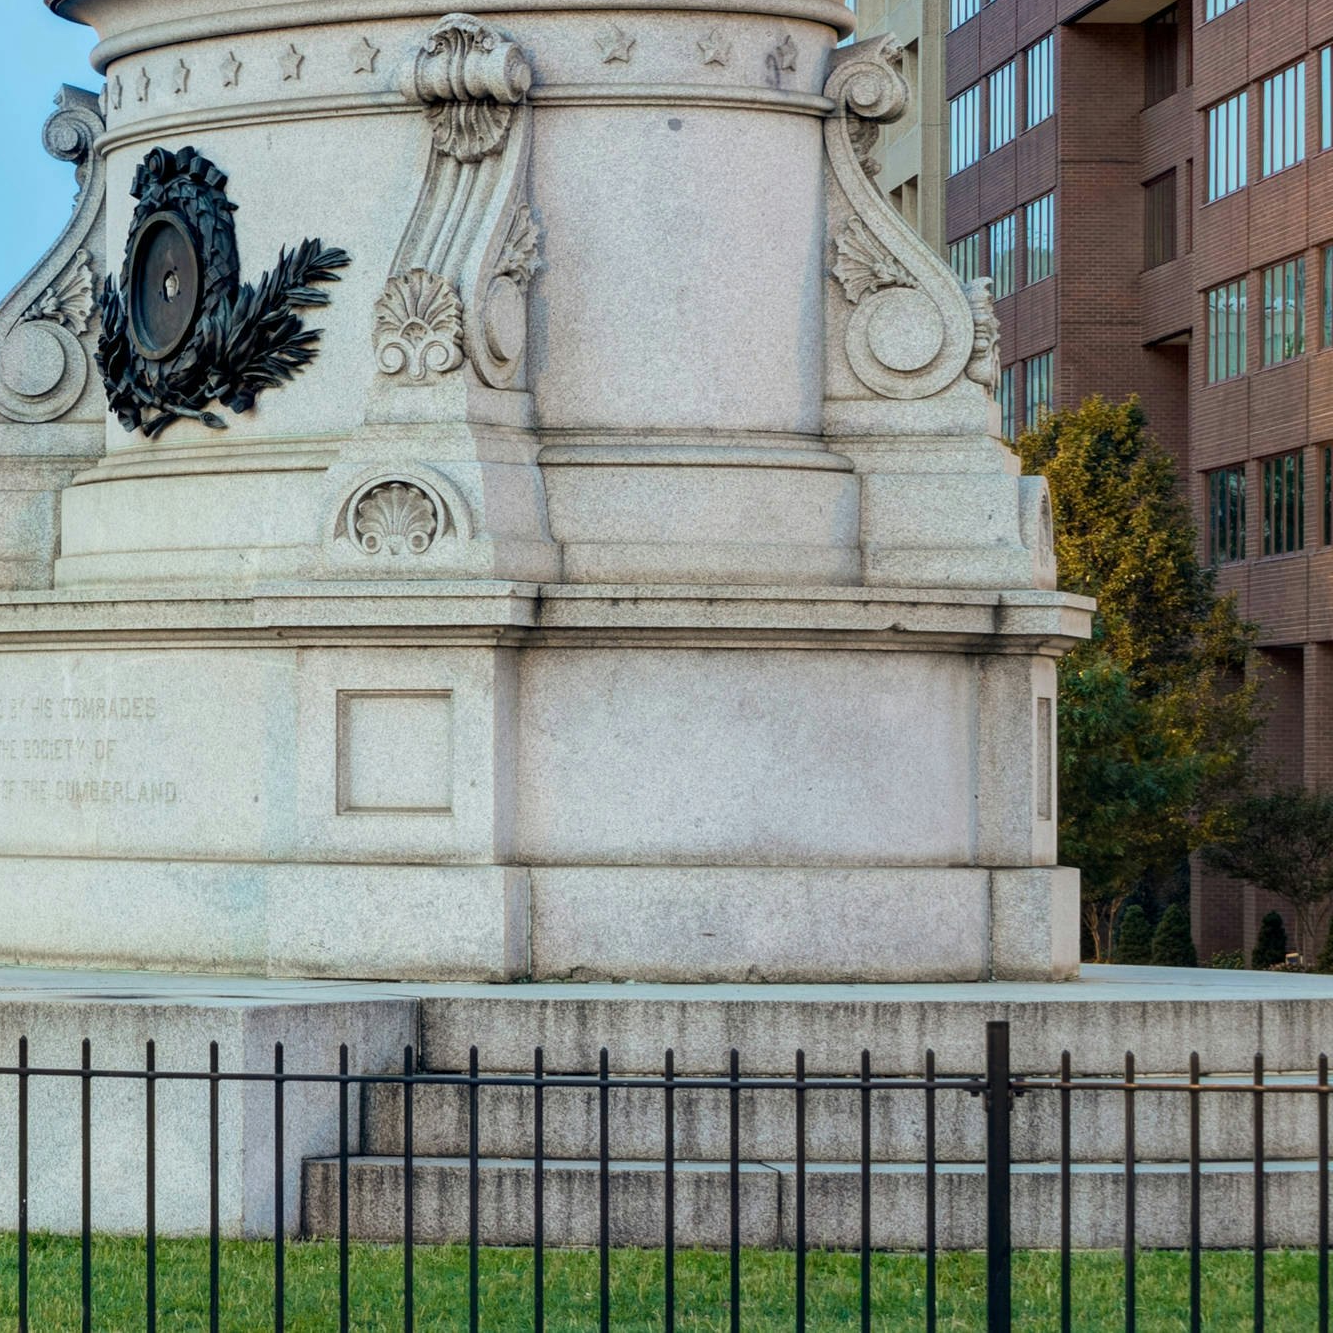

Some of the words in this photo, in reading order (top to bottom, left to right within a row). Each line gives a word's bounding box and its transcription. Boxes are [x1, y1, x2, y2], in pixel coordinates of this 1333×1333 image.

[31, 697, 54, 720] HIS
[61, 696, 156, 720] COMRADES
[23, 738, 85, 760] SOCIETY
[95, 739, 118, 760] OF
